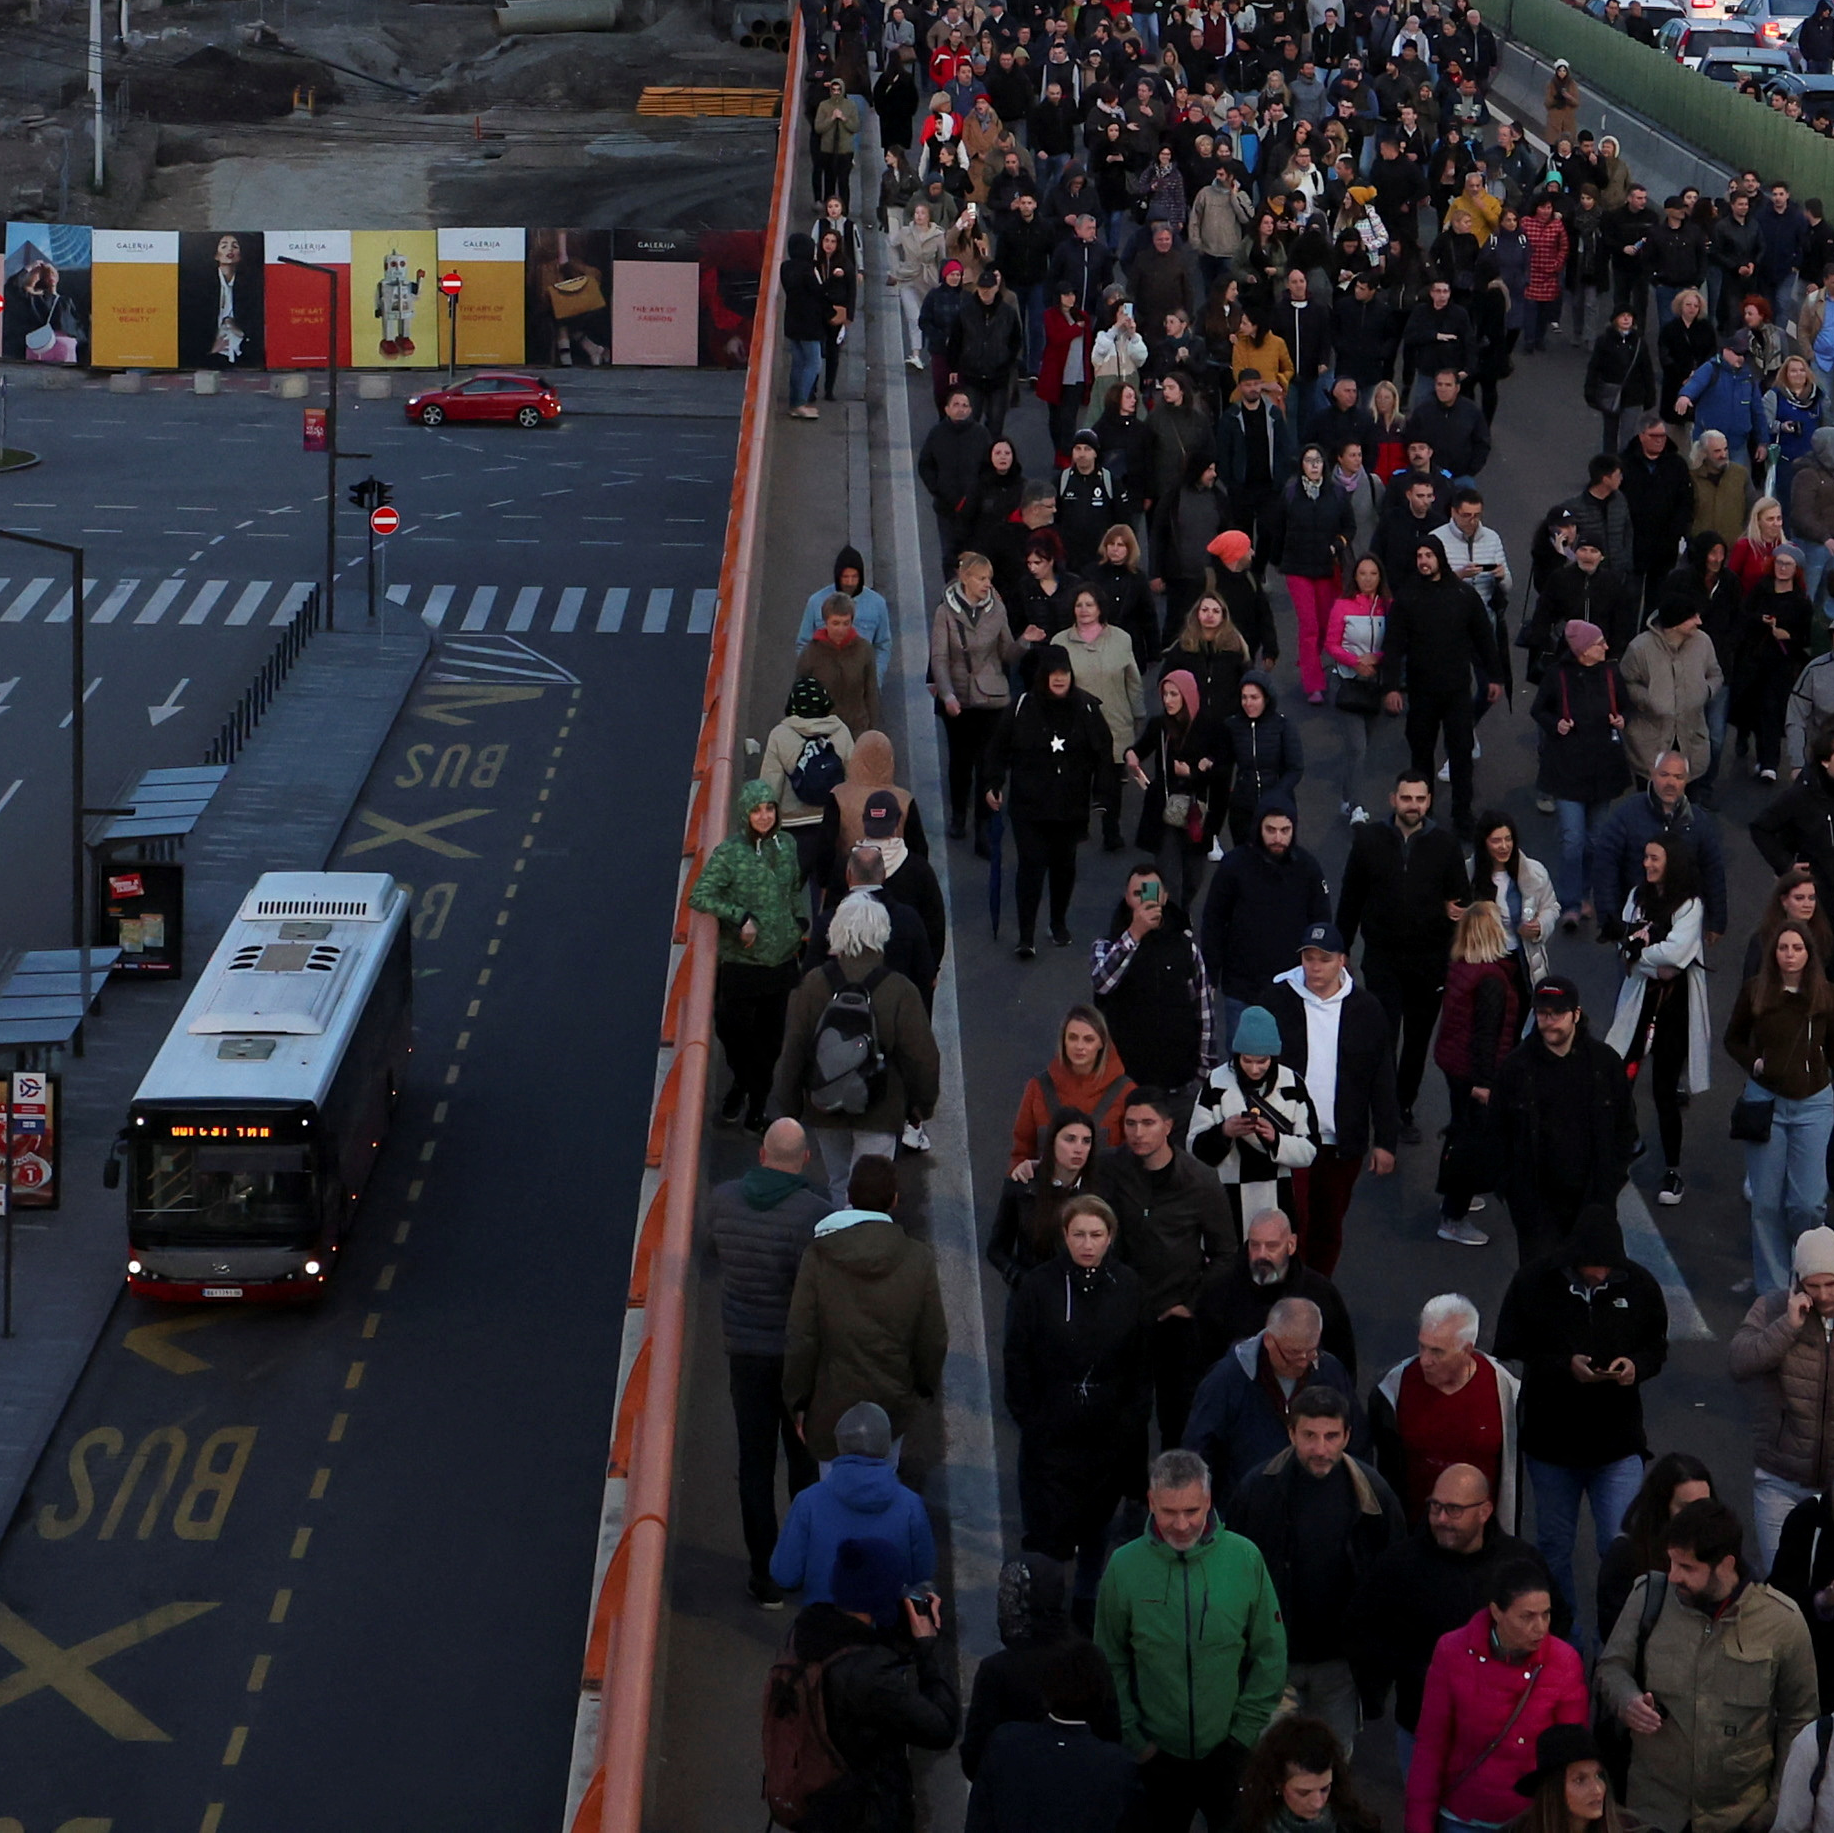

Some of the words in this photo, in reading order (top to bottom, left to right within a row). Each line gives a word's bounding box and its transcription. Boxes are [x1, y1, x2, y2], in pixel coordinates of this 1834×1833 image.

[116, 241, 154, 250] GALERIJA
[288, 243, 326, 251] GALERIJA
[463, 240, 501, 249] GALERIJA
[637, 241, 676, 250] GALERIJA
[393, 742, 510, 789] BUS
[35, 1424, 260, 1542] BUS
